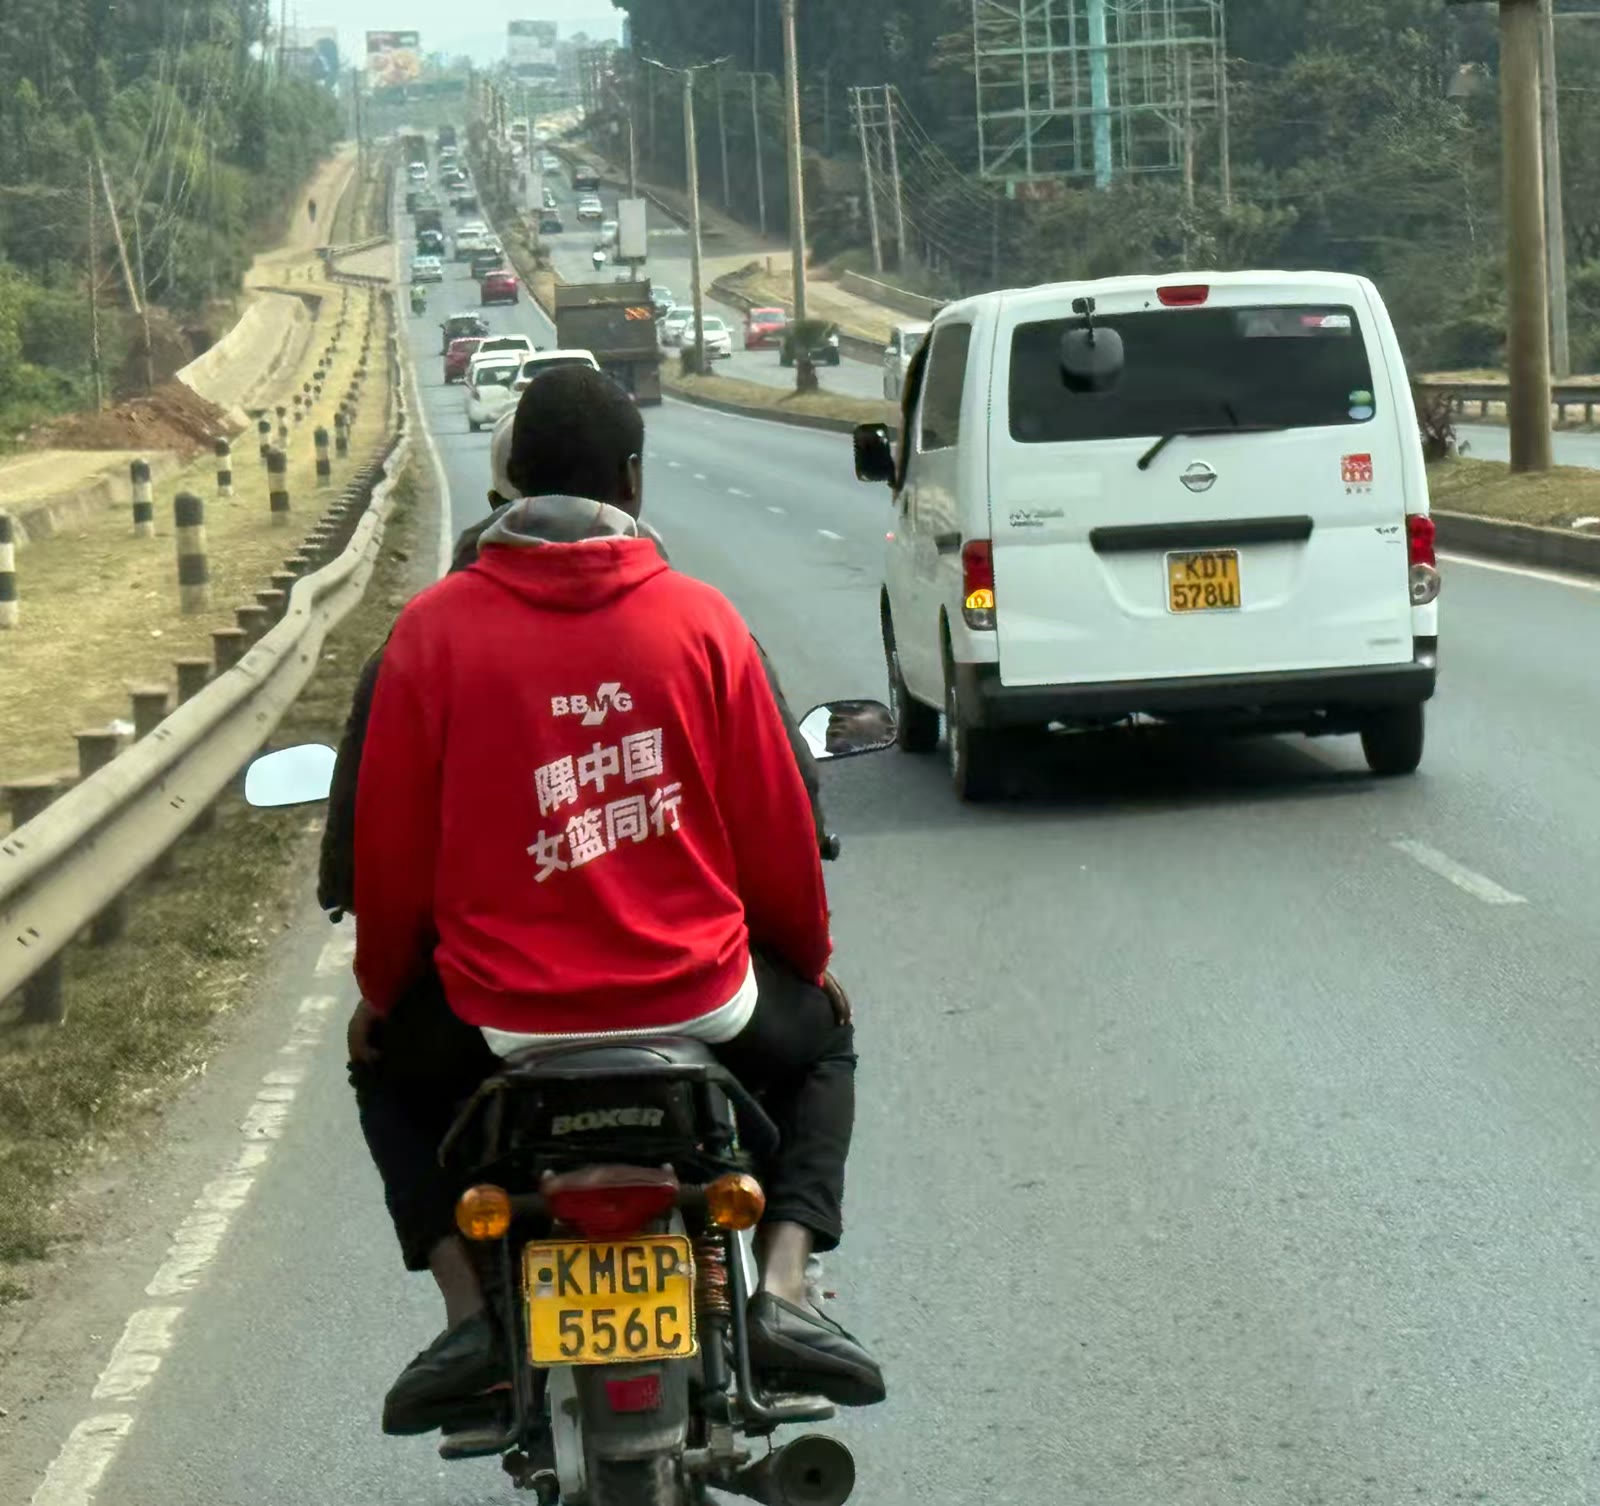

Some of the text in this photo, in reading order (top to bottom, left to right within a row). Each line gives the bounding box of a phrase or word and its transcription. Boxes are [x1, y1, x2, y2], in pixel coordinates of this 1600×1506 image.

[1186, 553, 1235, 580] KDT
[1173, 582, 1234, 609] 578U
[527, 782, 682, 882] 女篮同行
[552, 1108, 664, 1135] BOXER
[557, 1246, 681, 1296] KMGP
[559, 1306, 681, 1356] 556C
